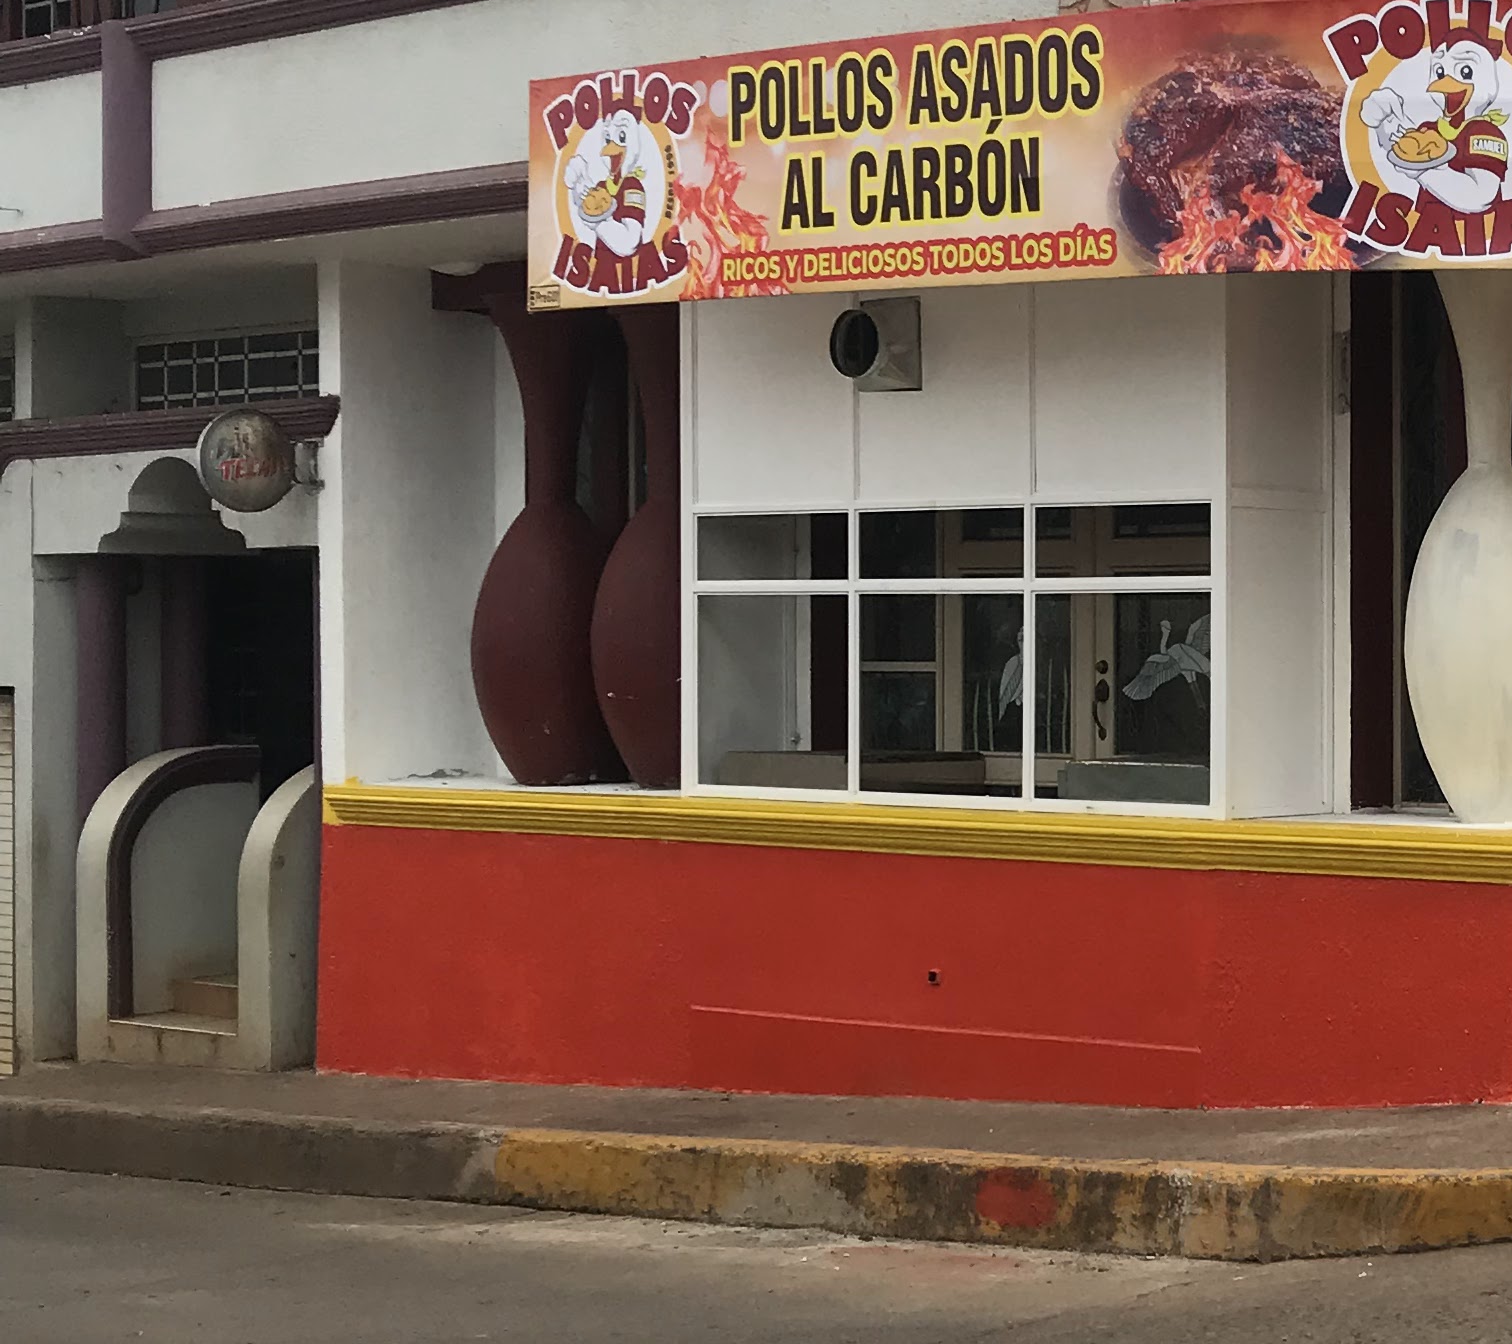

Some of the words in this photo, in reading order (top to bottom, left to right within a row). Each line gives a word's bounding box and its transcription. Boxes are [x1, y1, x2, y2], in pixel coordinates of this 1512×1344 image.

[547, 74, 697, 150] POLLOS
[731, 54, 893, 142] POLLOS
[909, 30, 1100, 125] ASADOS
[781, 156, 836, 229] AL
[850, 118, 1041, 226] CARBÓN
[723, 256, 780, 282] RICOS
[784, 254, 799, 279] Y
[804, 246, 926, 277] DELICIOSOS
[931, 241, 1004, 271] TODOS
[1011, 238, 1053, 264] LOS
[1059, 228, 1113, 261] DÍAS
